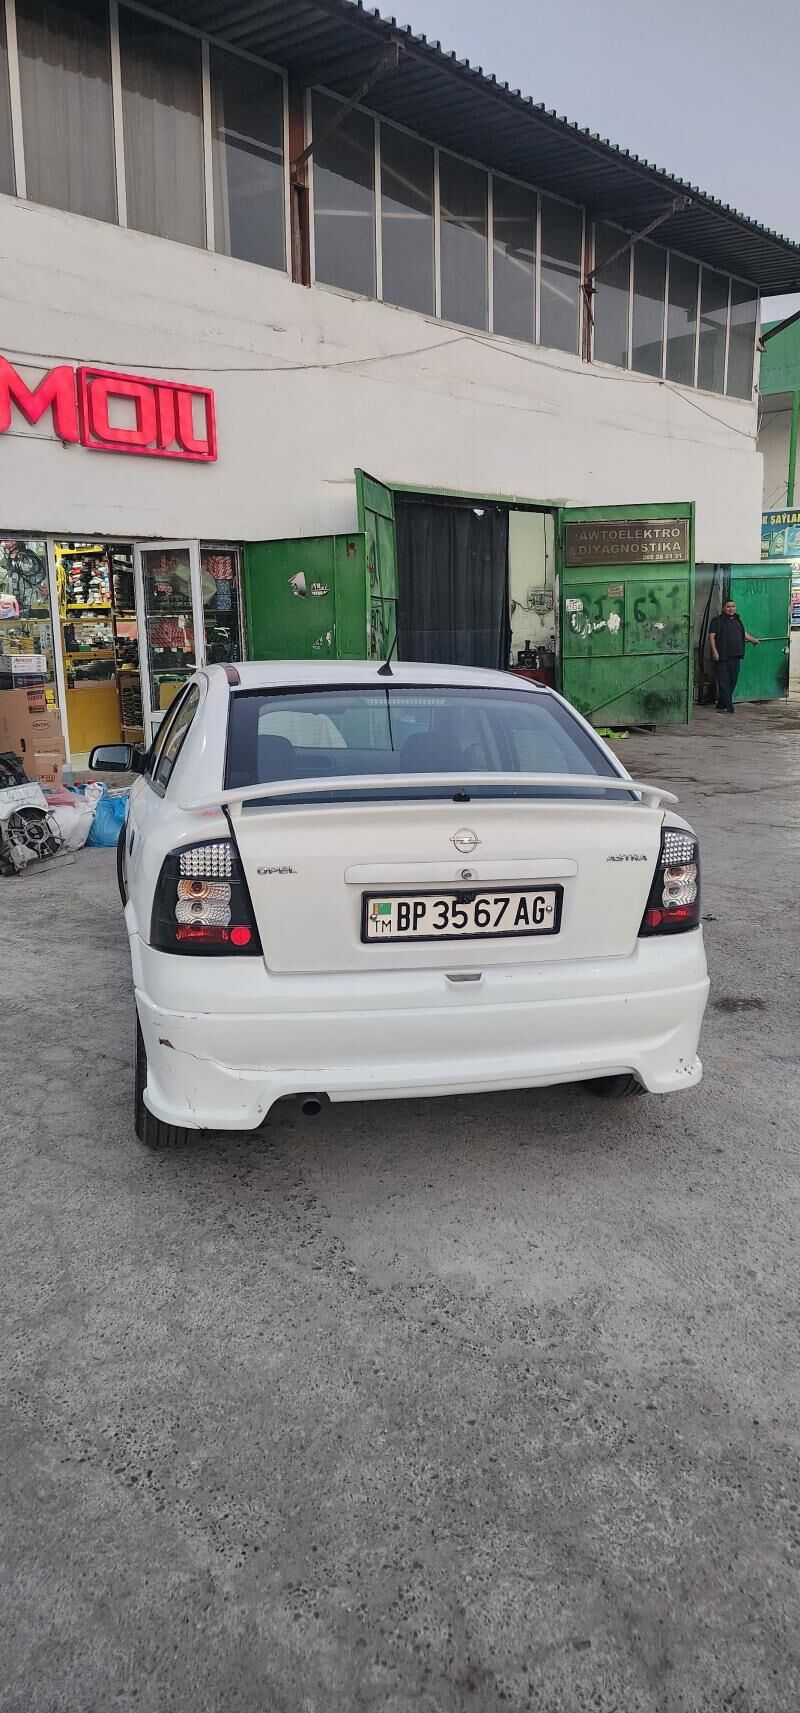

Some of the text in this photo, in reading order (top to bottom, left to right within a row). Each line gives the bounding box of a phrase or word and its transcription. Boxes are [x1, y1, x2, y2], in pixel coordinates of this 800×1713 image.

[579, 528, 681, 541] AWTOELEKTRO
[578, 542, 681, 555] DIYAGNOSTIKA
[606, 854, 648, 862] ASTRA
[256, 866, 298, 875] OPEL
[397, 902, 427, 931] BP
[513, 896, 546, 925] AG
[374, 920, 392, 933] TM
